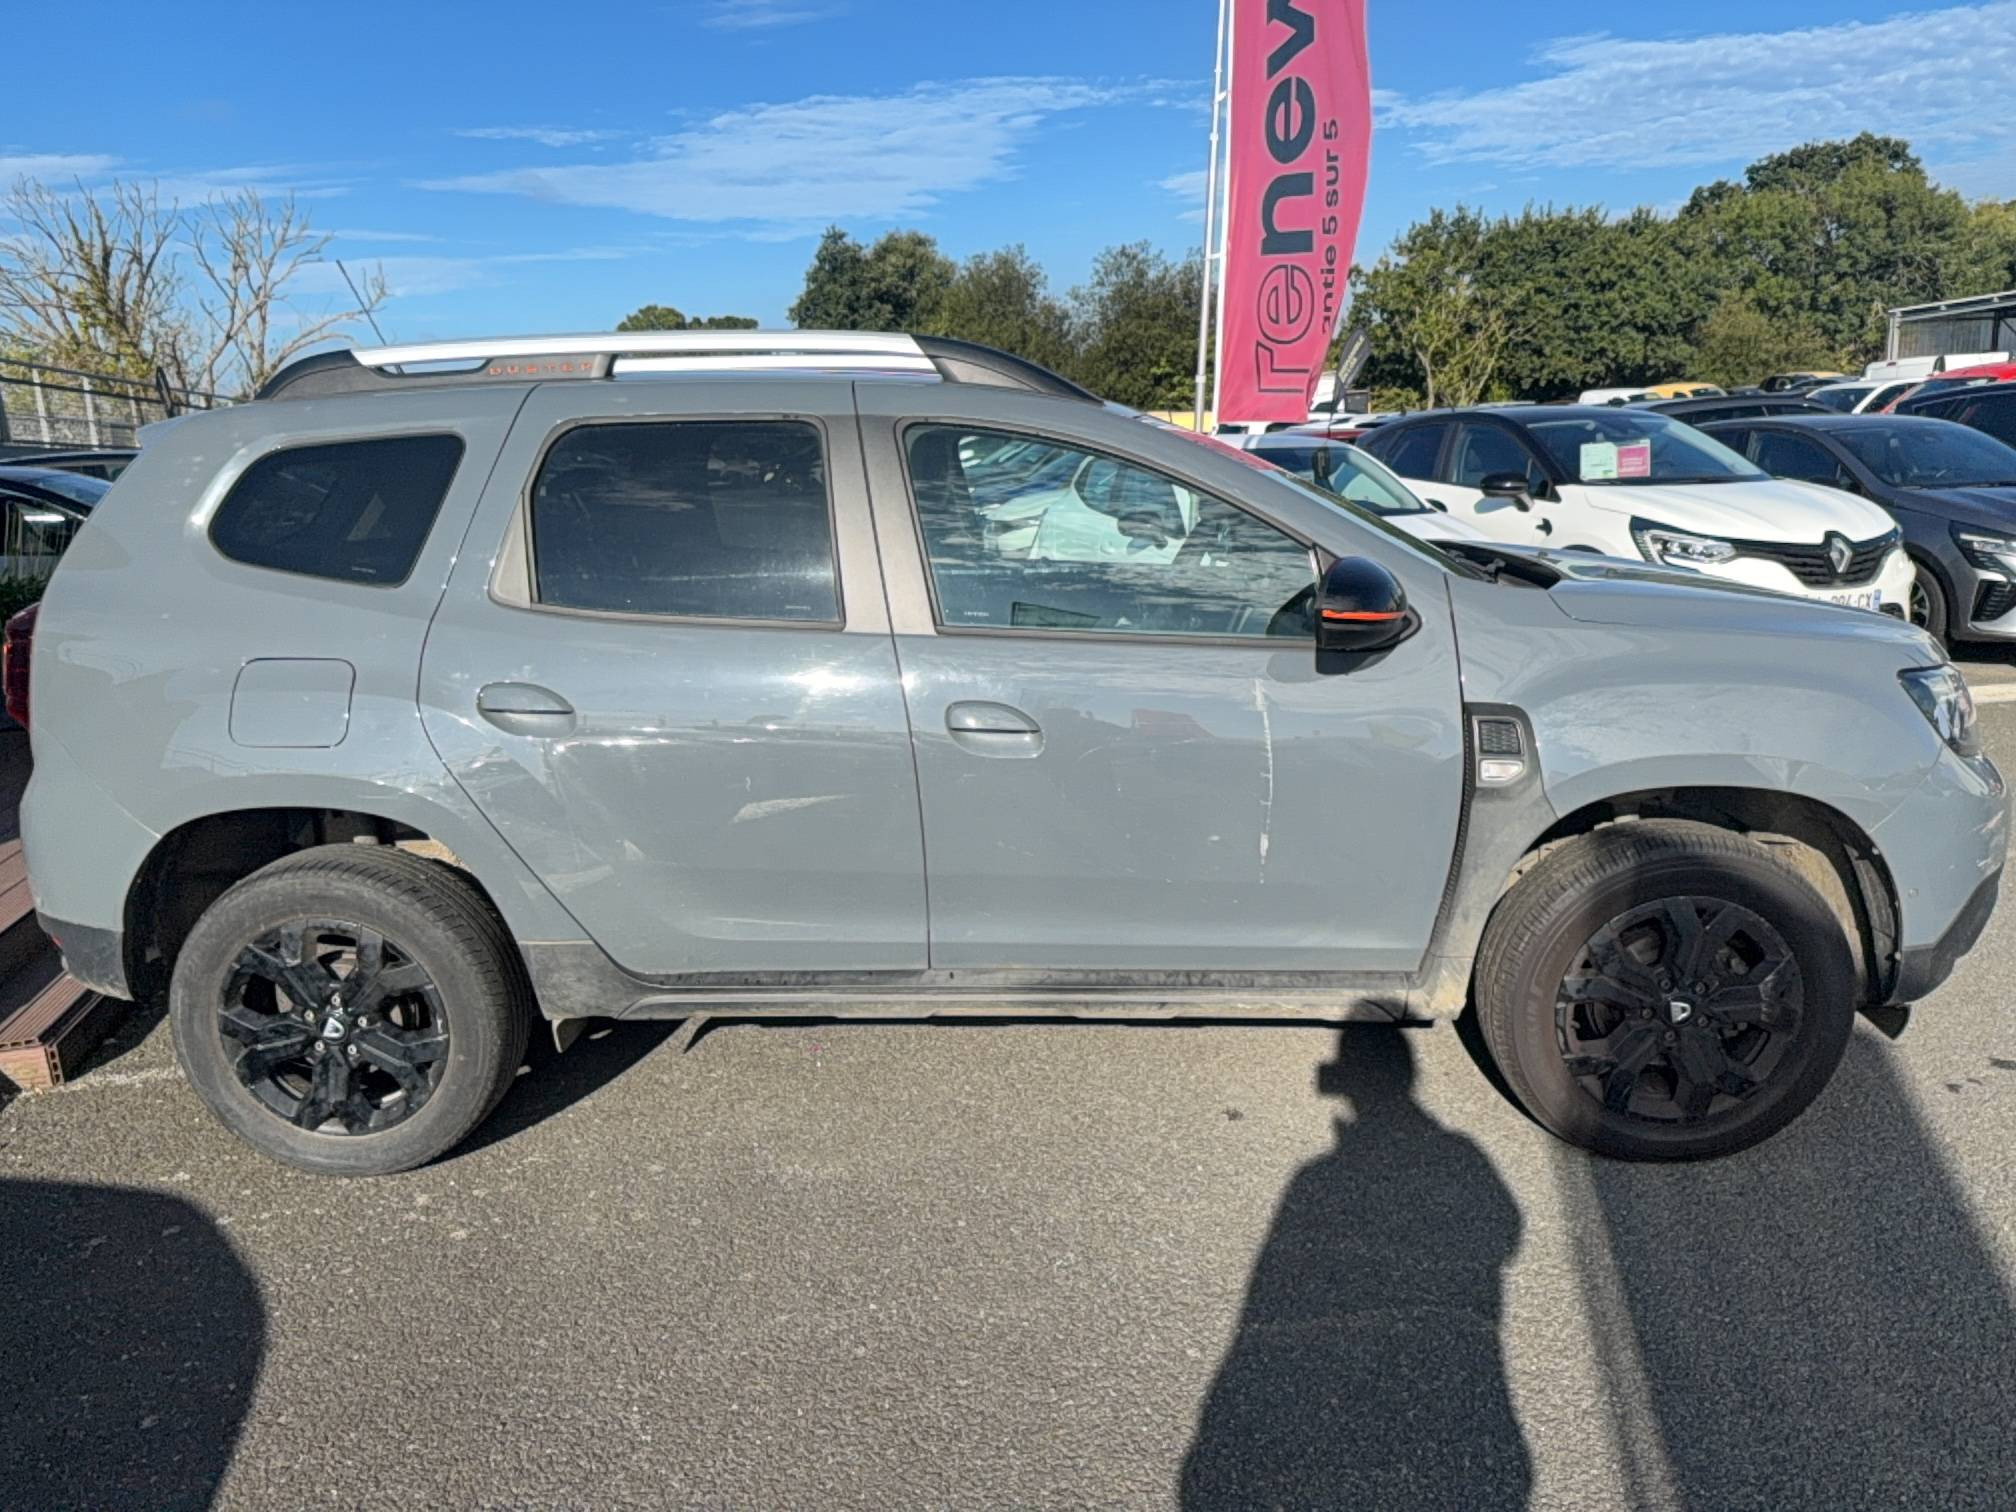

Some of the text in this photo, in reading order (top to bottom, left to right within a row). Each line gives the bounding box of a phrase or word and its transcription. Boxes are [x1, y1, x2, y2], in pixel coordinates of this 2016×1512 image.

[1323, 119, 1339, 140] 5
[1325, 148, 1340, 208] sur
[1322, 215, 1339, 235] 5
